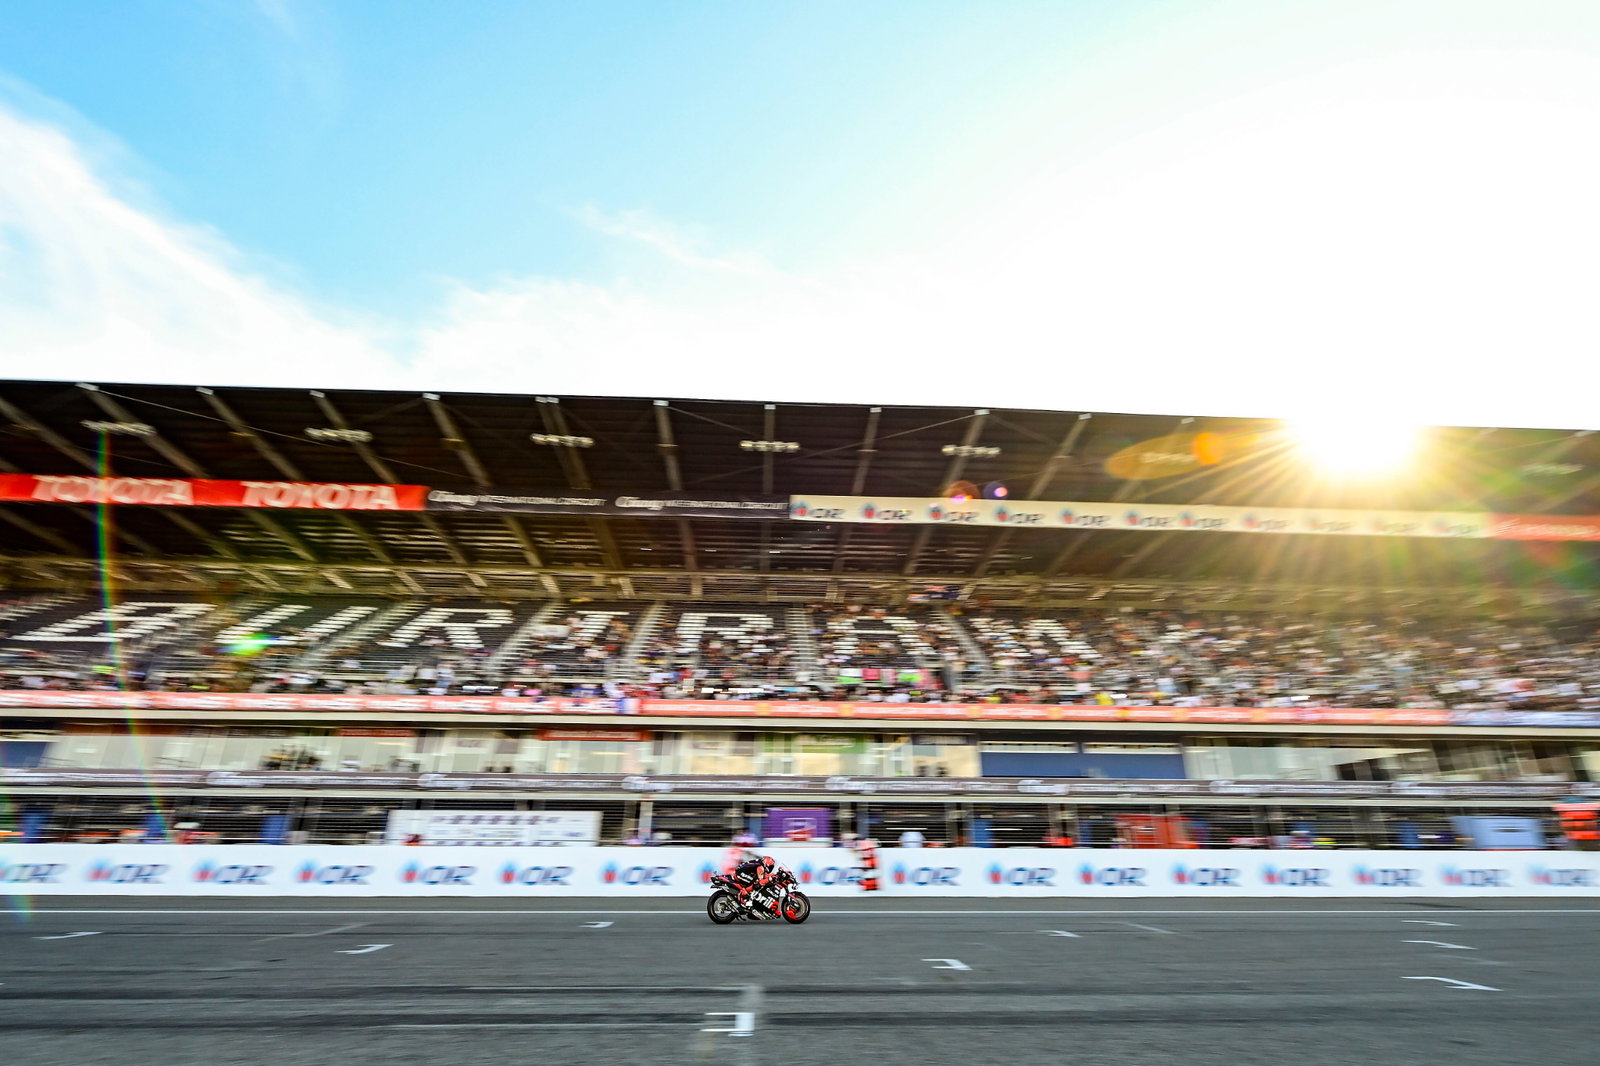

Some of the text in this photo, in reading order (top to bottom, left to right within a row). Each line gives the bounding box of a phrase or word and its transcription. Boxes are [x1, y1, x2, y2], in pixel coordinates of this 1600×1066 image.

[32, 475, 194, 505] TOYOTA
[240, 481, 399, 510] TOYOTA
[214, 865, 274, 885] OR
[317, 865, 375, 885] OR
[422, 866, 478, 885] OR
[518, 866, 574, 886] OR
[620, 866, 675, 886] OR
[913, 867, 961, 886] OR
[1006, 867, 1058, 886] OR
[1099, 867, 1148, 886] OR
[1193, 868, 1242, 887] OR
[1282, 868, 1333, 887] OR
